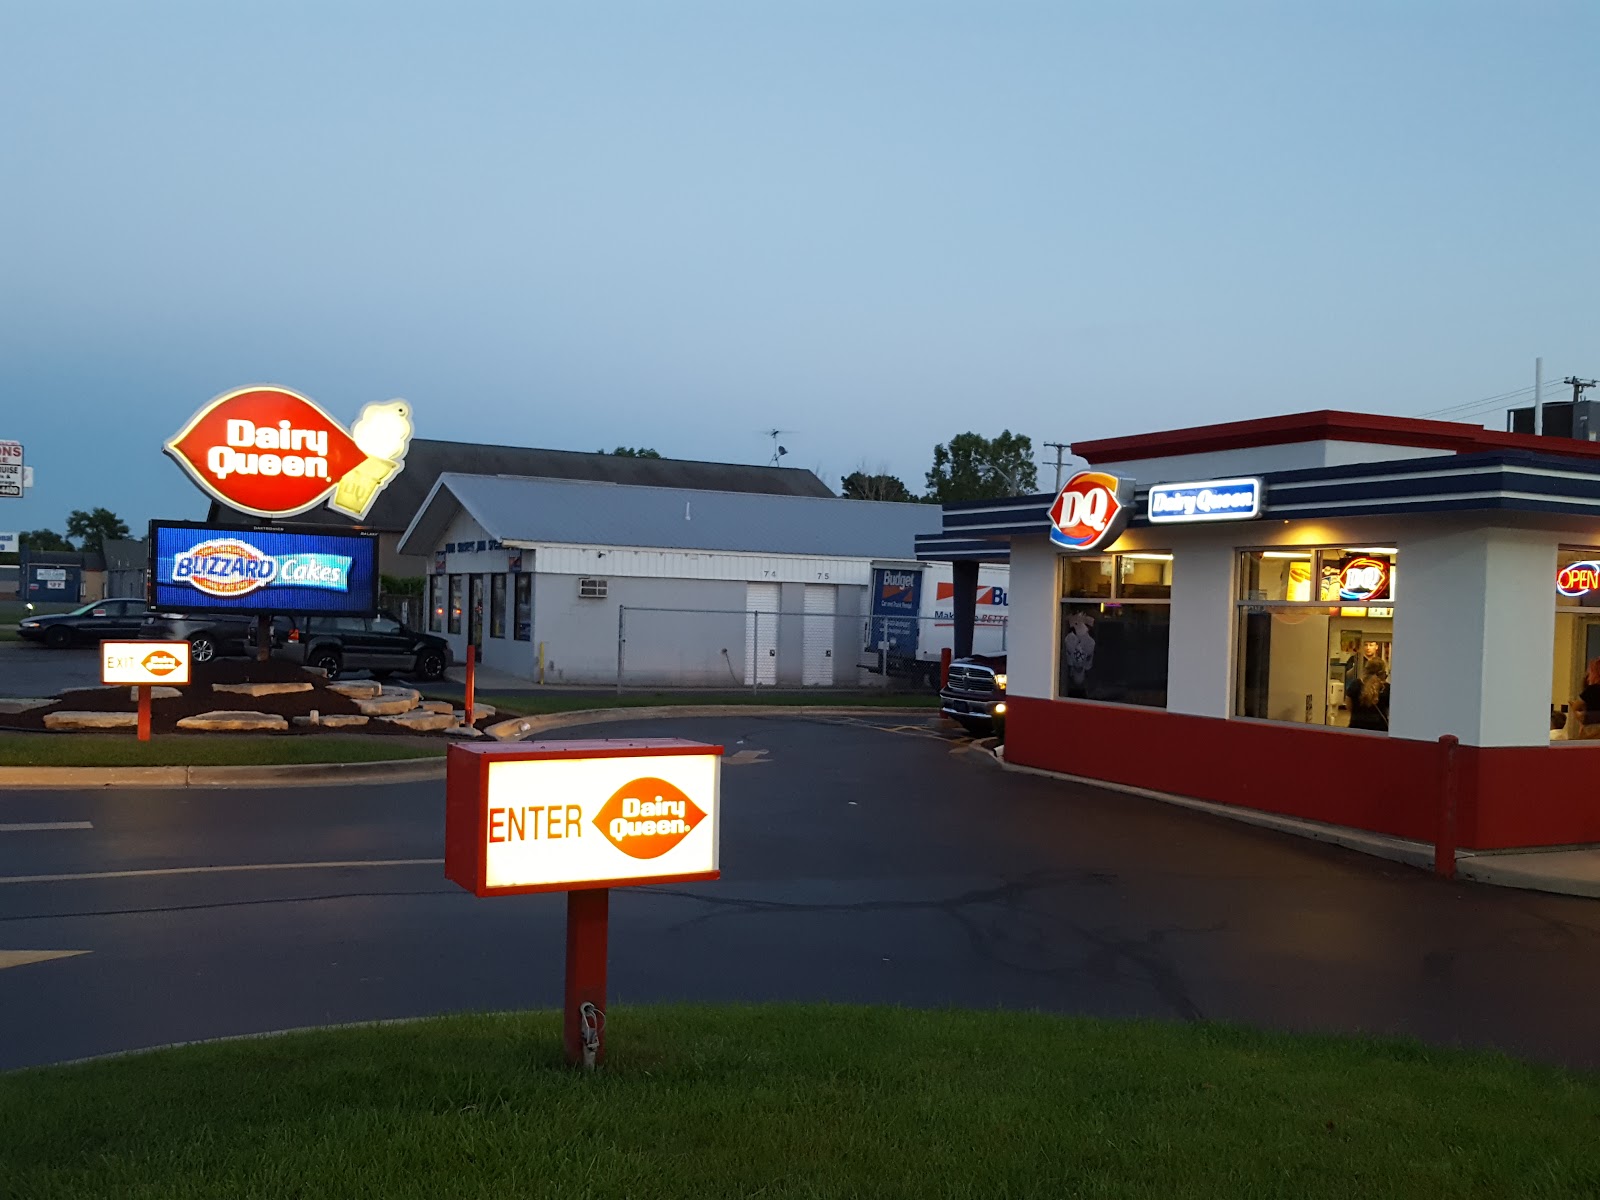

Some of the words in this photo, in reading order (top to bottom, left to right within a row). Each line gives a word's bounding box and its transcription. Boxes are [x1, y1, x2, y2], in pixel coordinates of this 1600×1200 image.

[227, 419, 327, 456] Dairy
[0, 447, 21, 457] NS
[1059, 488, 1107, 531] DQ
[1153, 493, 1196, 515] Dairy
[176, 557, 275, 579] BLIZZARD
[281, 559, 341, 582] Cakes
[883, 571, 914, 590] Budget
[1558, 569, 1598, 589] OPEN
[993, 586, 1008, 606] Bu
[107, 656, 134, 668] EXIT
[622, 796, 685, 818] Dairy
[489, 804, 582, 843] ENTER
